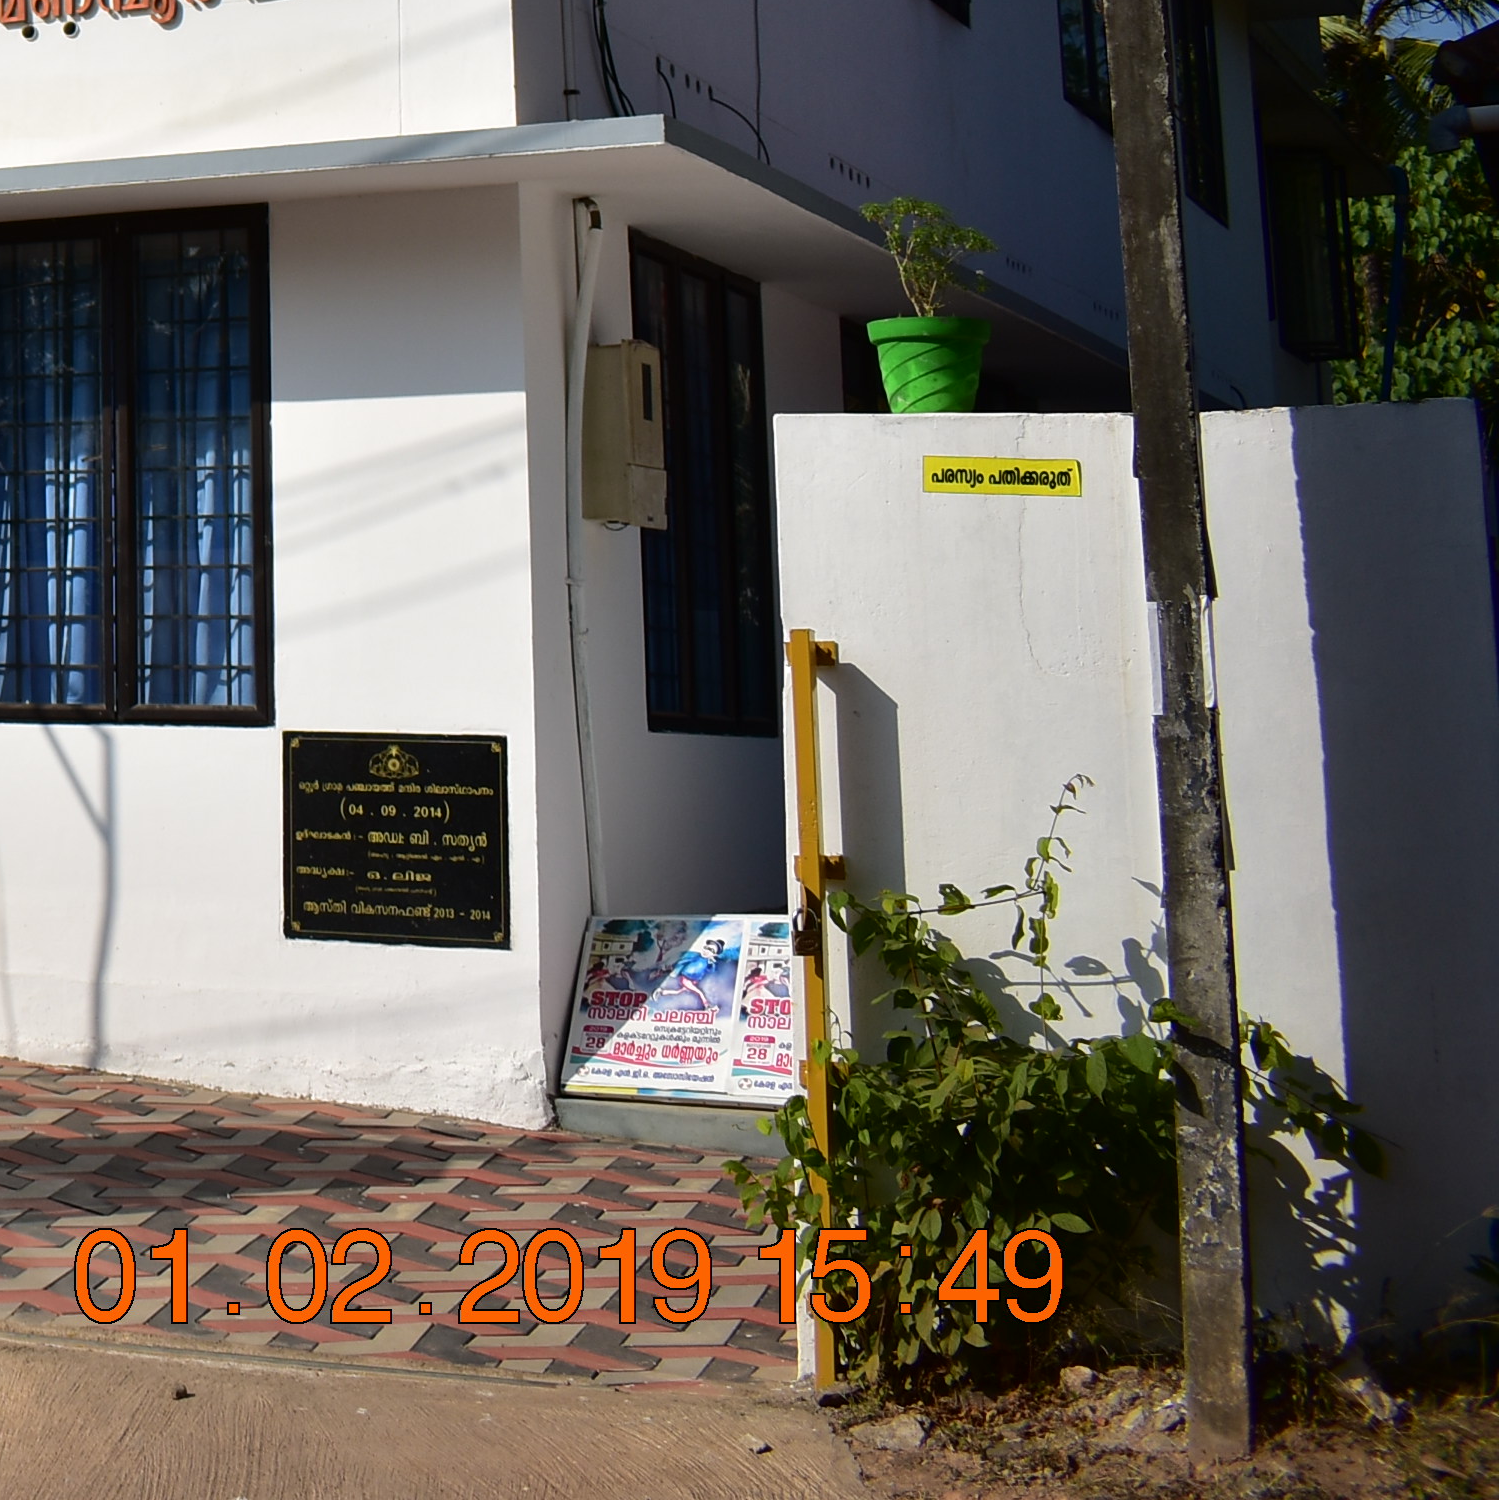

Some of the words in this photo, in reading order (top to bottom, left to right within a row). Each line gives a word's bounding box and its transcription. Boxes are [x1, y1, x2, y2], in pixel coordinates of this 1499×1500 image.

[932, 468, 984, 488] പരസ്യം
[988, 467, 1073, 489] പതിക്കരുത്
[591, 991, 648, 1007] STOP
[588, 1006, 648, 1021] സാലറി
[586, 1037, 606, 1049] 28
[747, 1047, 767, 1060] 28
